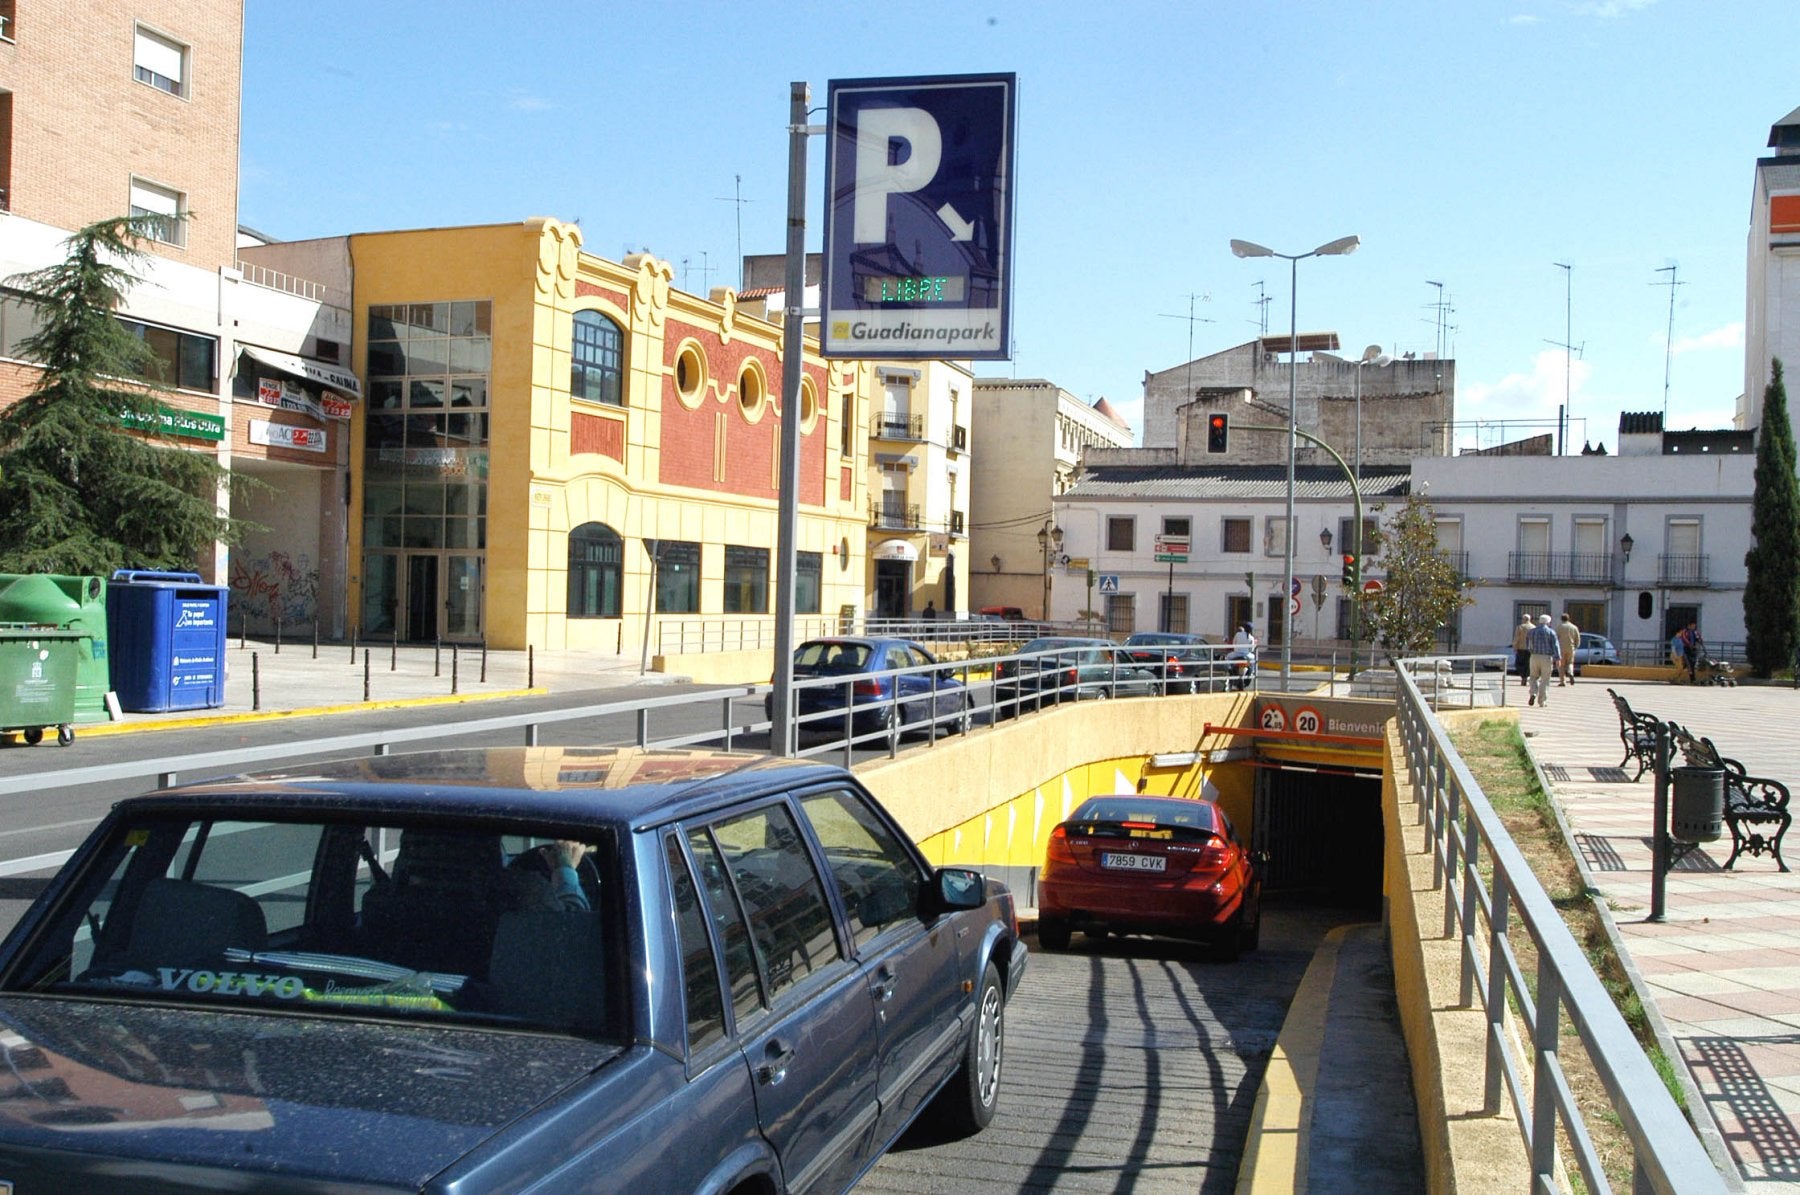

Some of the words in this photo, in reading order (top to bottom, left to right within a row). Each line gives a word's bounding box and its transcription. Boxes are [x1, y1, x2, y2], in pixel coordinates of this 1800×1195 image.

[854, 108, 942, 244] P
[881, 278, 948, 302] LIBRE
[851, 321, 995, 344] Guadianapark
[1300, 716, 1316, 731] 20
[1109, 855, 1136, 867] 7859
[1141, 857, 1163, 869] CVK
[156, 967, 304, 1000] VOLVO
